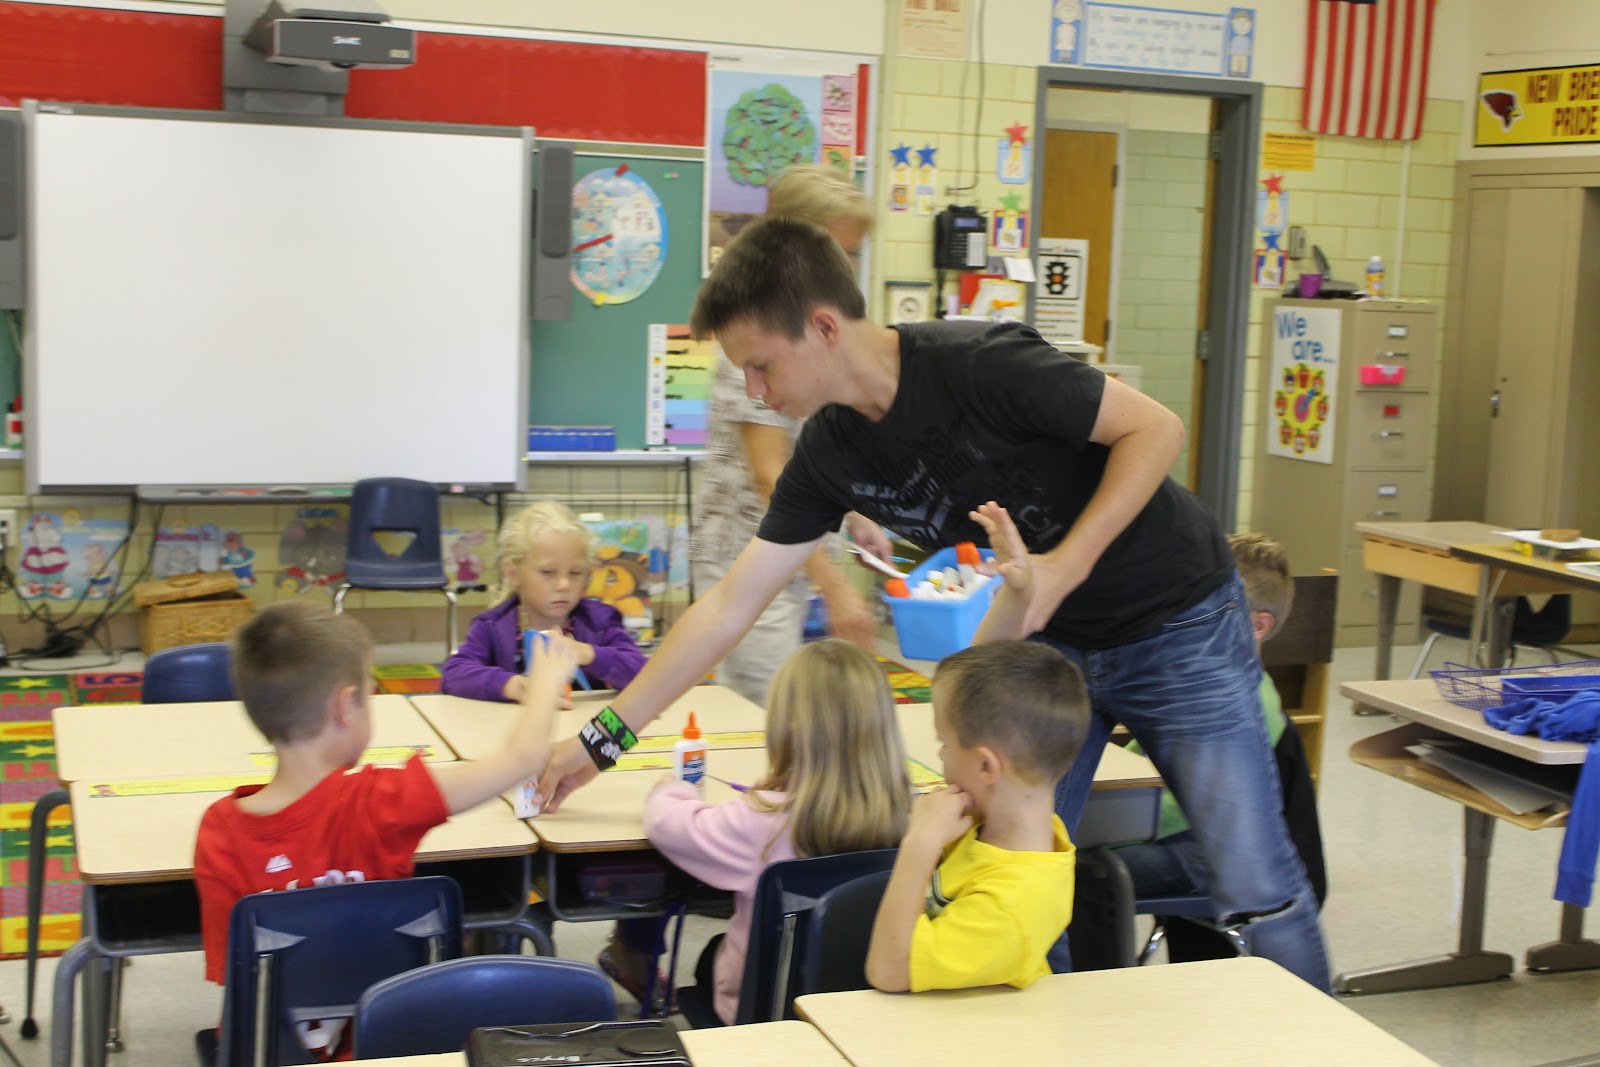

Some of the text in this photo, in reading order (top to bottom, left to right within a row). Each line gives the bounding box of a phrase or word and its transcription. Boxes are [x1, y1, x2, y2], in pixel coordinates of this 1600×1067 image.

[1526, 74, 1562, 104] NEW
[1552, 105, 1597, 137] PRIDE
[1274, 311, 1307, 339] We
